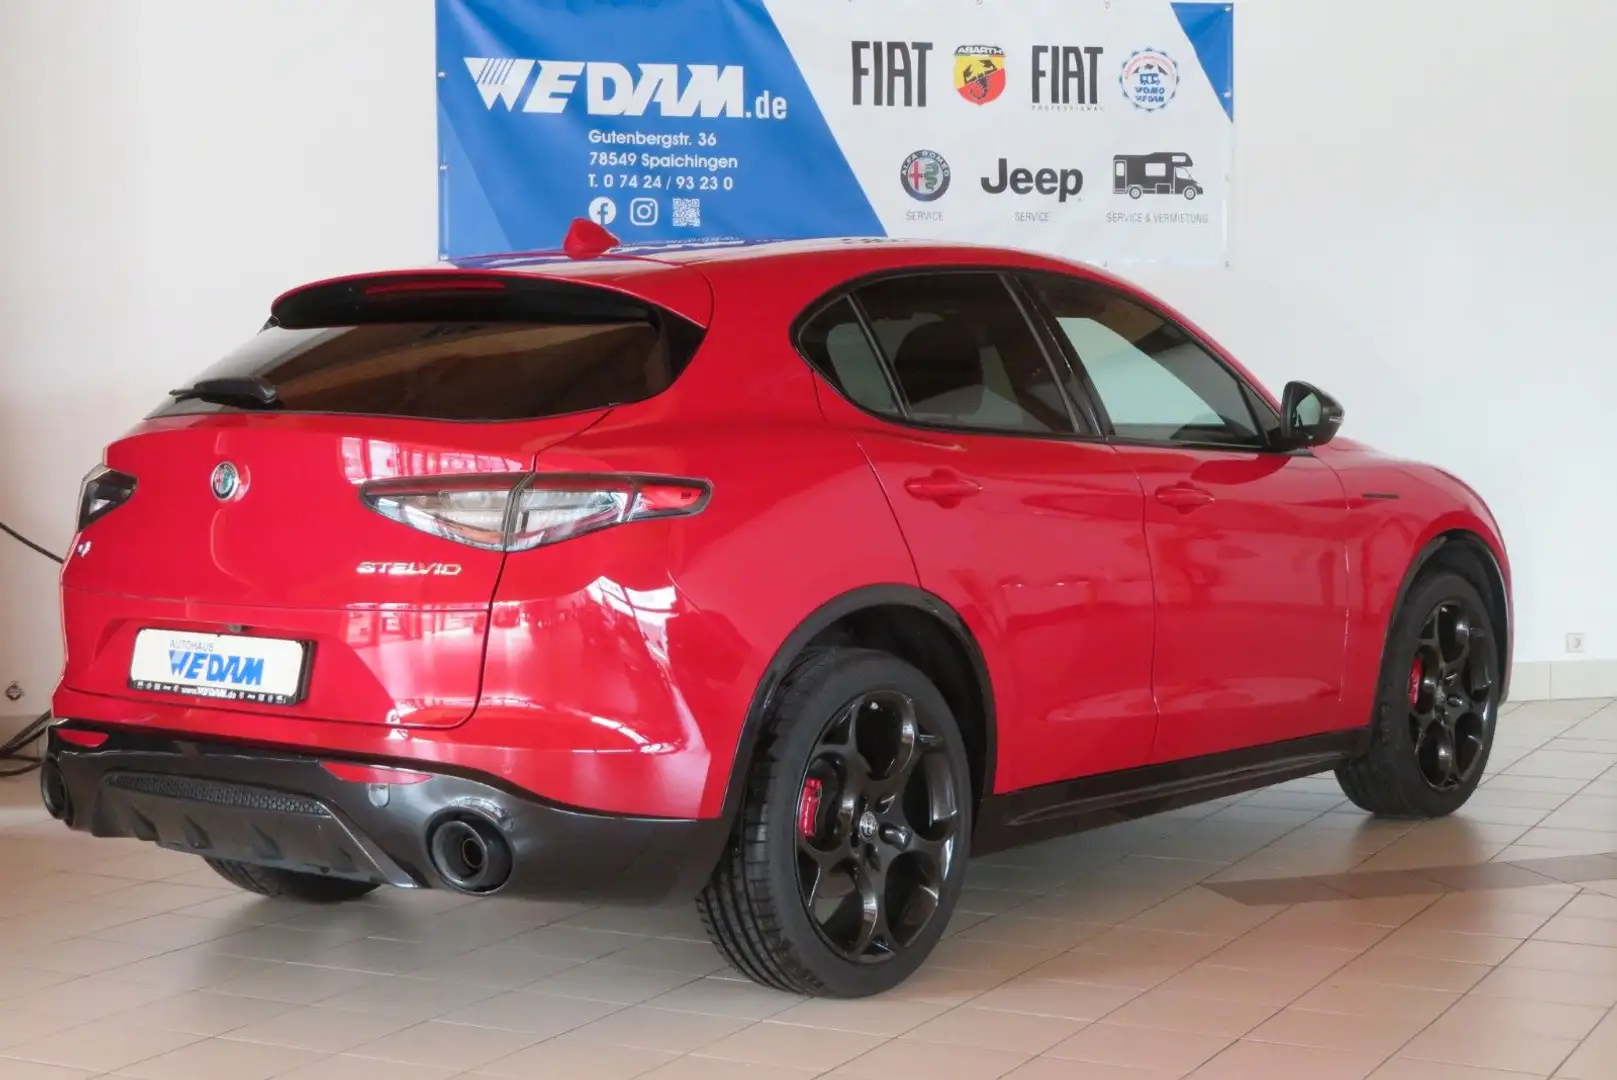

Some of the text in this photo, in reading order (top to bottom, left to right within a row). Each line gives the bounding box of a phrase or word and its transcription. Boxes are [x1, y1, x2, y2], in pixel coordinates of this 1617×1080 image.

[957, 45, 1003, 55] ABARTH
[852, 41, 933, 107] FIAT
[1032, 45, 1104, 104] FIAT
[588, 129, 717, 148] Gutenbergstr. 36
[590, 152, 738, 171] 78549 Spaichingen
[902, 150, 950, 177] ALFA ROMEO
[588, 174, 598, 187] T.
[603, 174, 614, 188] 0
[619, 175, 638, 188] 74
[643, 175, 662, 188] 24
[676, 176, 695, 190] 93
[699, 176, 718, 190] 23
[723, 177, 734, 190] 0
[980, 158, 1083, 202] Jeep
[905, 211, 944, 221] SERVICE
[1014, 212, 1050, 222] SERVICE
[1106, 213, 1143, 223] SERVICE
[1153, 213, 1209, 224] VERMIETUNG
[356, 561, 462, 575] STELVIO
[169, 639, 215, 652] AUTOHAUS
[169, 650, 265, 686] WEDAM
